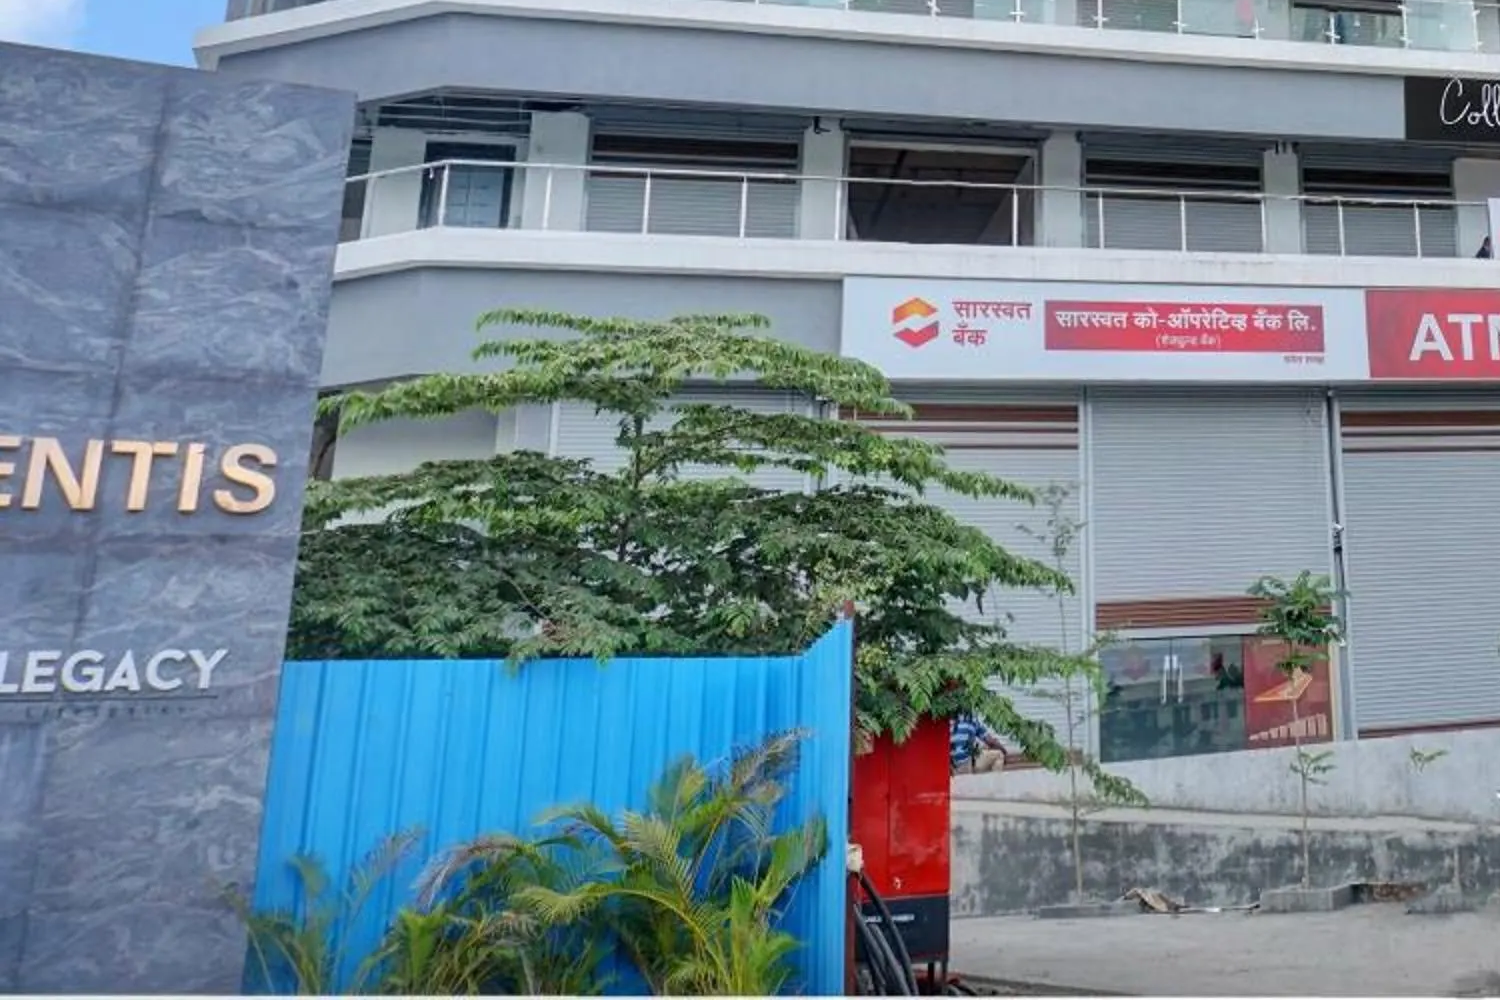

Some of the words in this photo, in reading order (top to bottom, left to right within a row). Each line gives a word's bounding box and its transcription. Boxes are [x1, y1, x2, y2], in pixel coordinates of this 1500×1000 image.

[952, 301, 1032, 320] सारस्वत
[1055, 310, 1129, 329] सारस्वत
[1252, 309, 1282, 330] बँक
[952, 323, 988, 347] बँक
[0, 649, 229, 693] LEGACY
